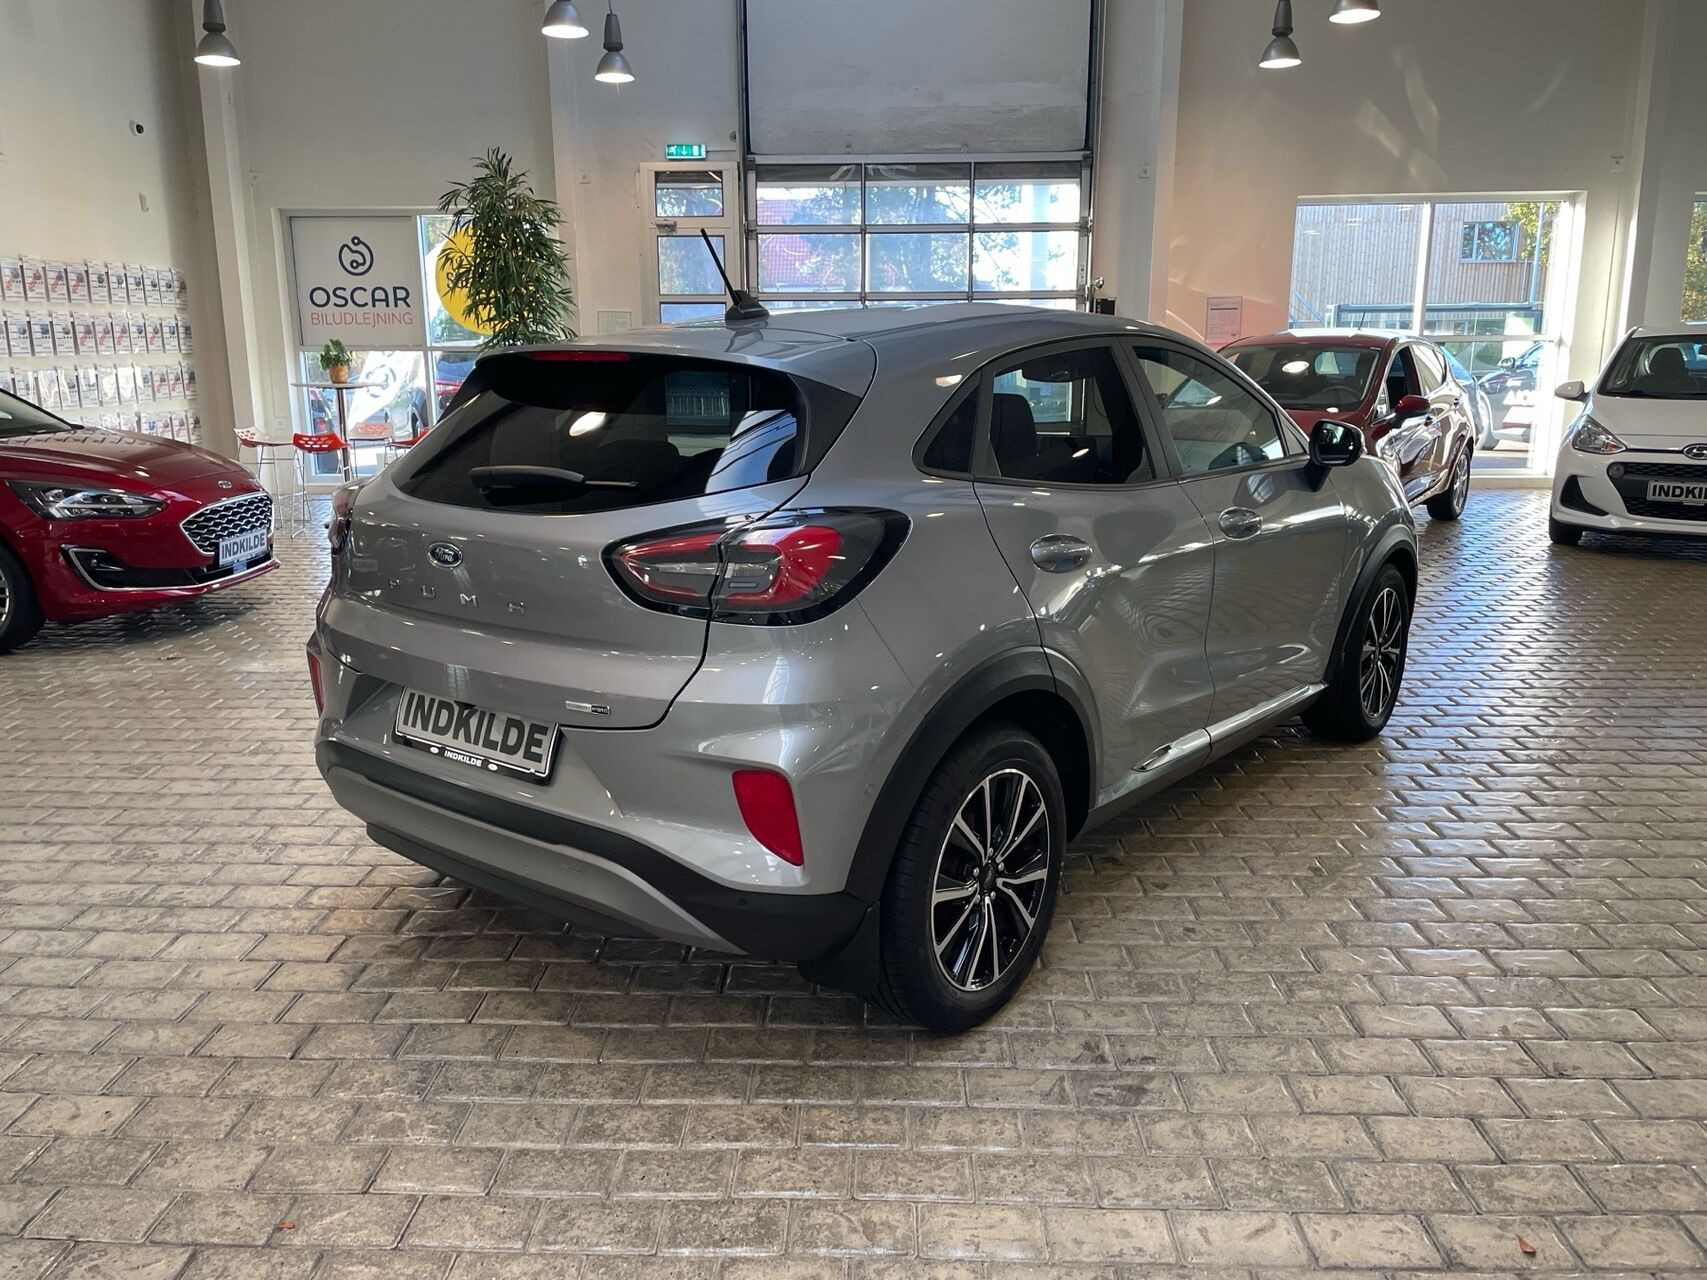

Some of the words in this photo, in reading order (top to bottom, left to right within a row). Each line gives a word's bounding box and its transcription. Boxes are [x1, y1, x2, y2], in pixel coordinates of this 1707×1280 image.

[309, 286, 411, 308] OSCAR
[311, 312, 413, 327] BILUDLEJNING
[221, 533, 266, 559] INDKILDE
[402, 692, 549, 764] INDKILDE
[444, 750, 483, 767] INDKILDE
